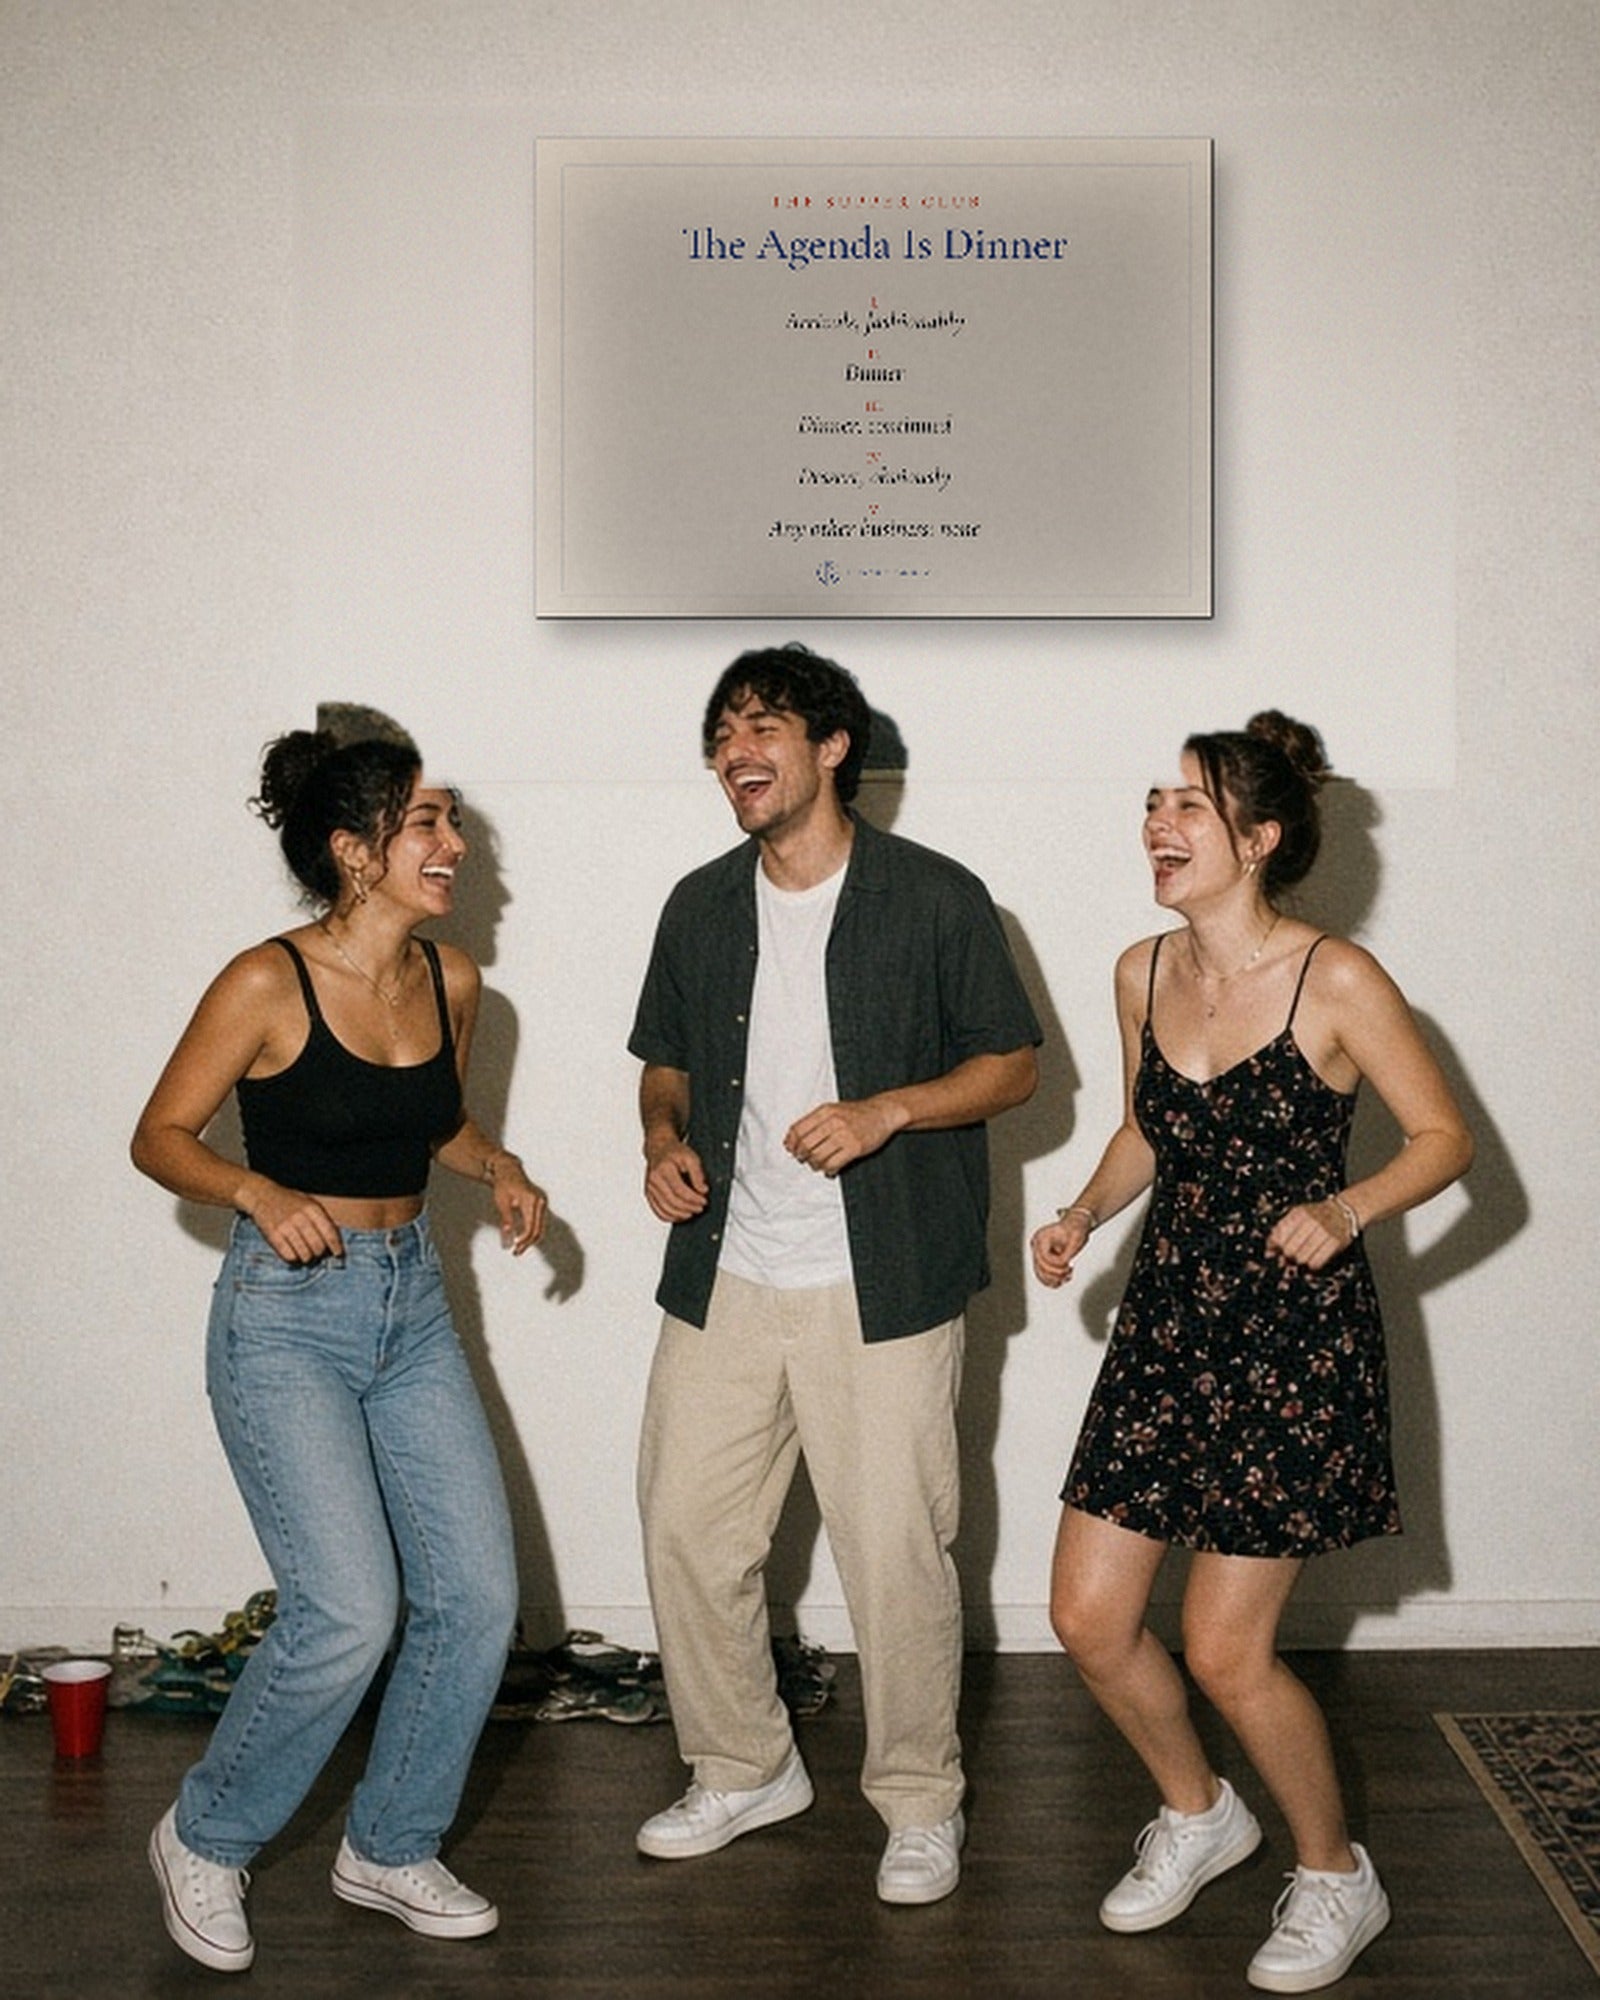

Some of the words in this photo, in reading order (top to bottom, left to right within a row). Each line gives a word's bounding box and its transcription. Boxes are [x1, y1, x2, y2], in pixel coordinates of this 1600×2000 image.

[682, 227, 746, 259] The
[755, 224, 890, 271] Agenda
[903, 229, 933, 259] Is
[944, 227, 1068, 259] Dinner
[846, 363, 906, 382] Dinner
[768, 520, 807, 542] Any
[810, 517, 856, 537] other
